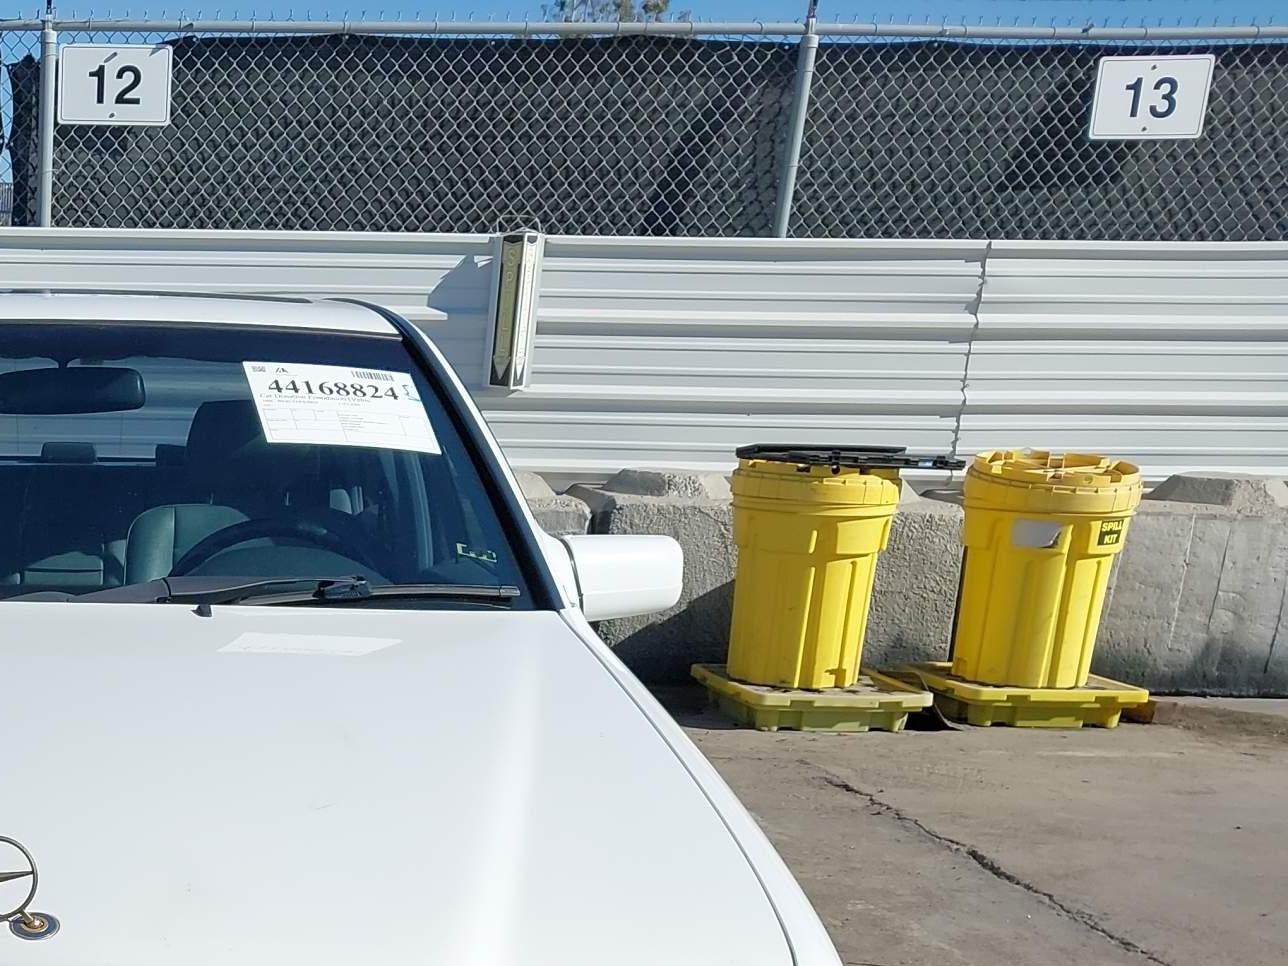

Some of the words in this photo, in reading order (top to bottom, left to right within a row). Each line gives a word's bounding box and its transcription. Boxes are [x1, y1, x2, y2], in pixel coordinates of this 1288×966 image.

[88, 64, 142, 105] 12
[1125, 76, 1179, 119] 13
[268, 379, 400, 401] 44168824
[1101, 520, 1123, 532] SPILL
[1103, 533, 1118, 545] KIT
